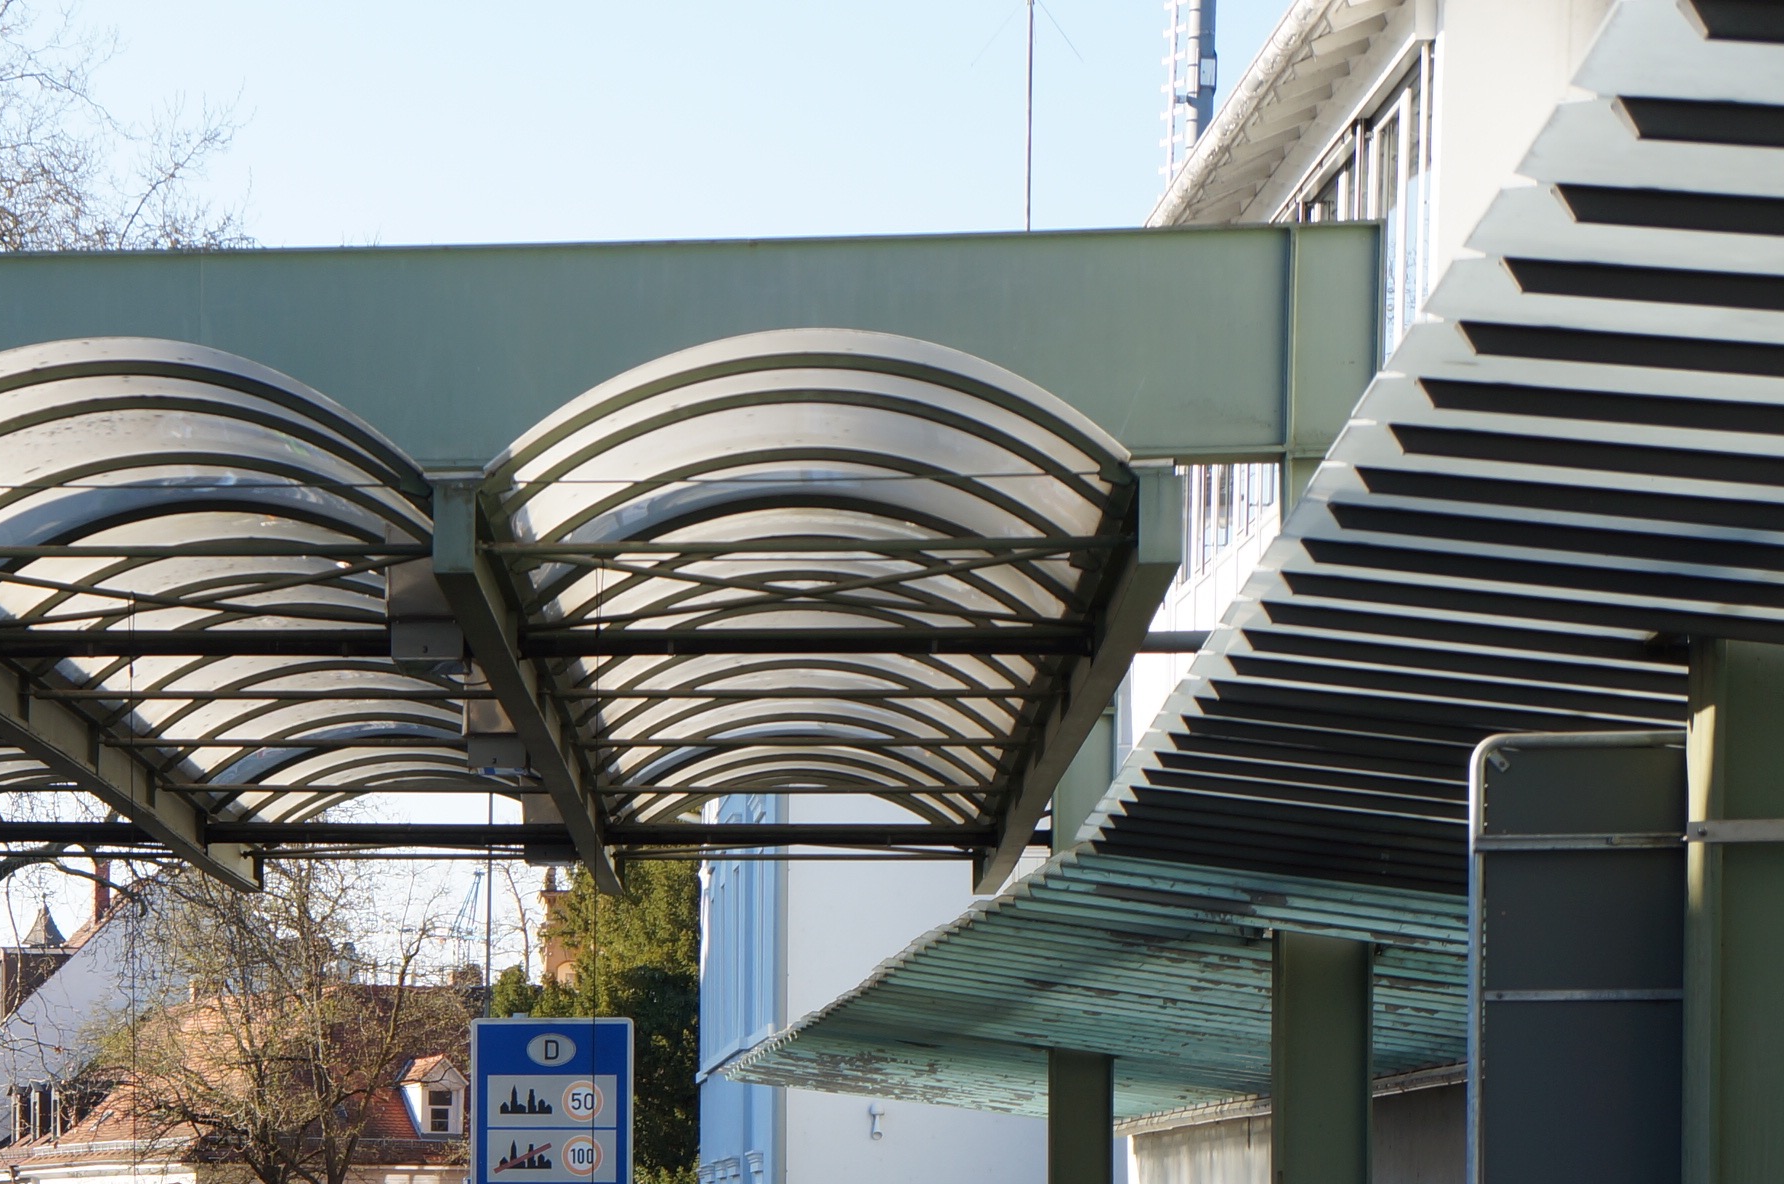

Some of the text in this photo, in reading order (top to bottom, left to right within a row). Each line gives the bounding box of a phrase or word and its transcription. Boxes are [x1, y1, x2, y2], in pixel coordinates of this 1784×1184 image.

[544, 1039, 559, 1060] D
[571, 1093, 595, 1110] 50
[570, 1148, 594, 1164] 100
